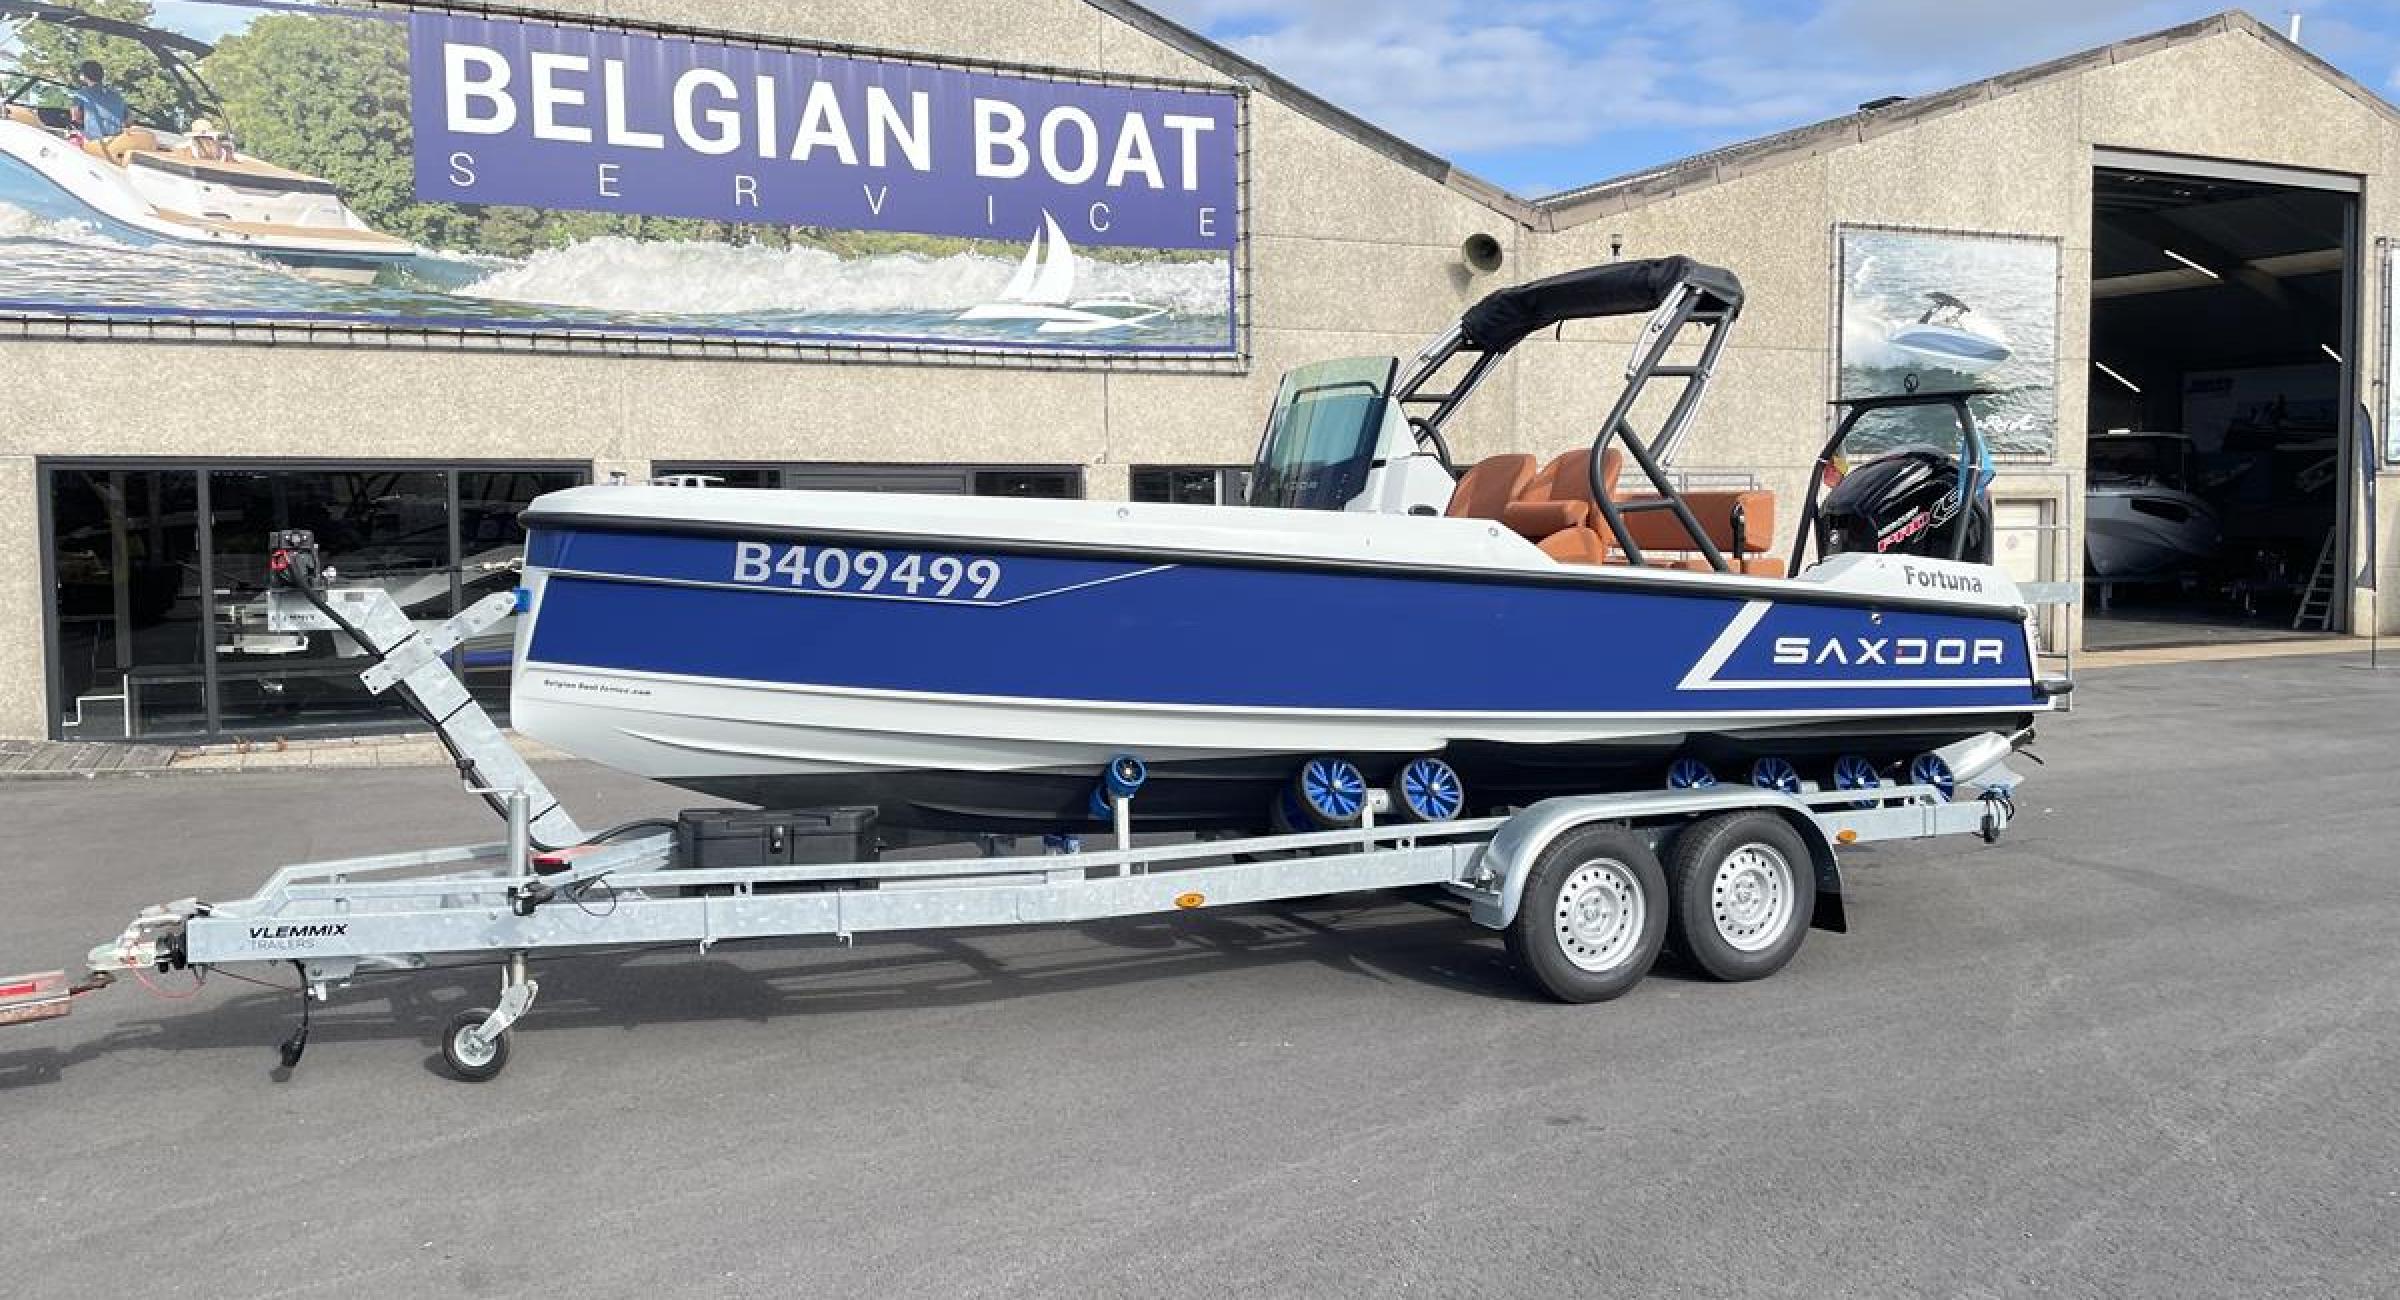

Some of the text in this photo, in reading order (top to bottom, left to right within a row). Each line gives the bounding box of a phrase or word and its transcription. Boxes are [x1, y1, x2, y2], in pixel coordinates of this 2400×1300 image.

[444, 42, 1215, 191] BELGIAN BOAT
[449, 151, 1217, 238] SERVICE
[1878, 511, 1931, 553] PRO
[733, 541, 1001, 599] B409499
[1903, 565, 1983, 593] Fortuna
[1773, 637, 2004, 665] SAXDOR
[249, 923, 349, 939] VLEMMIX
